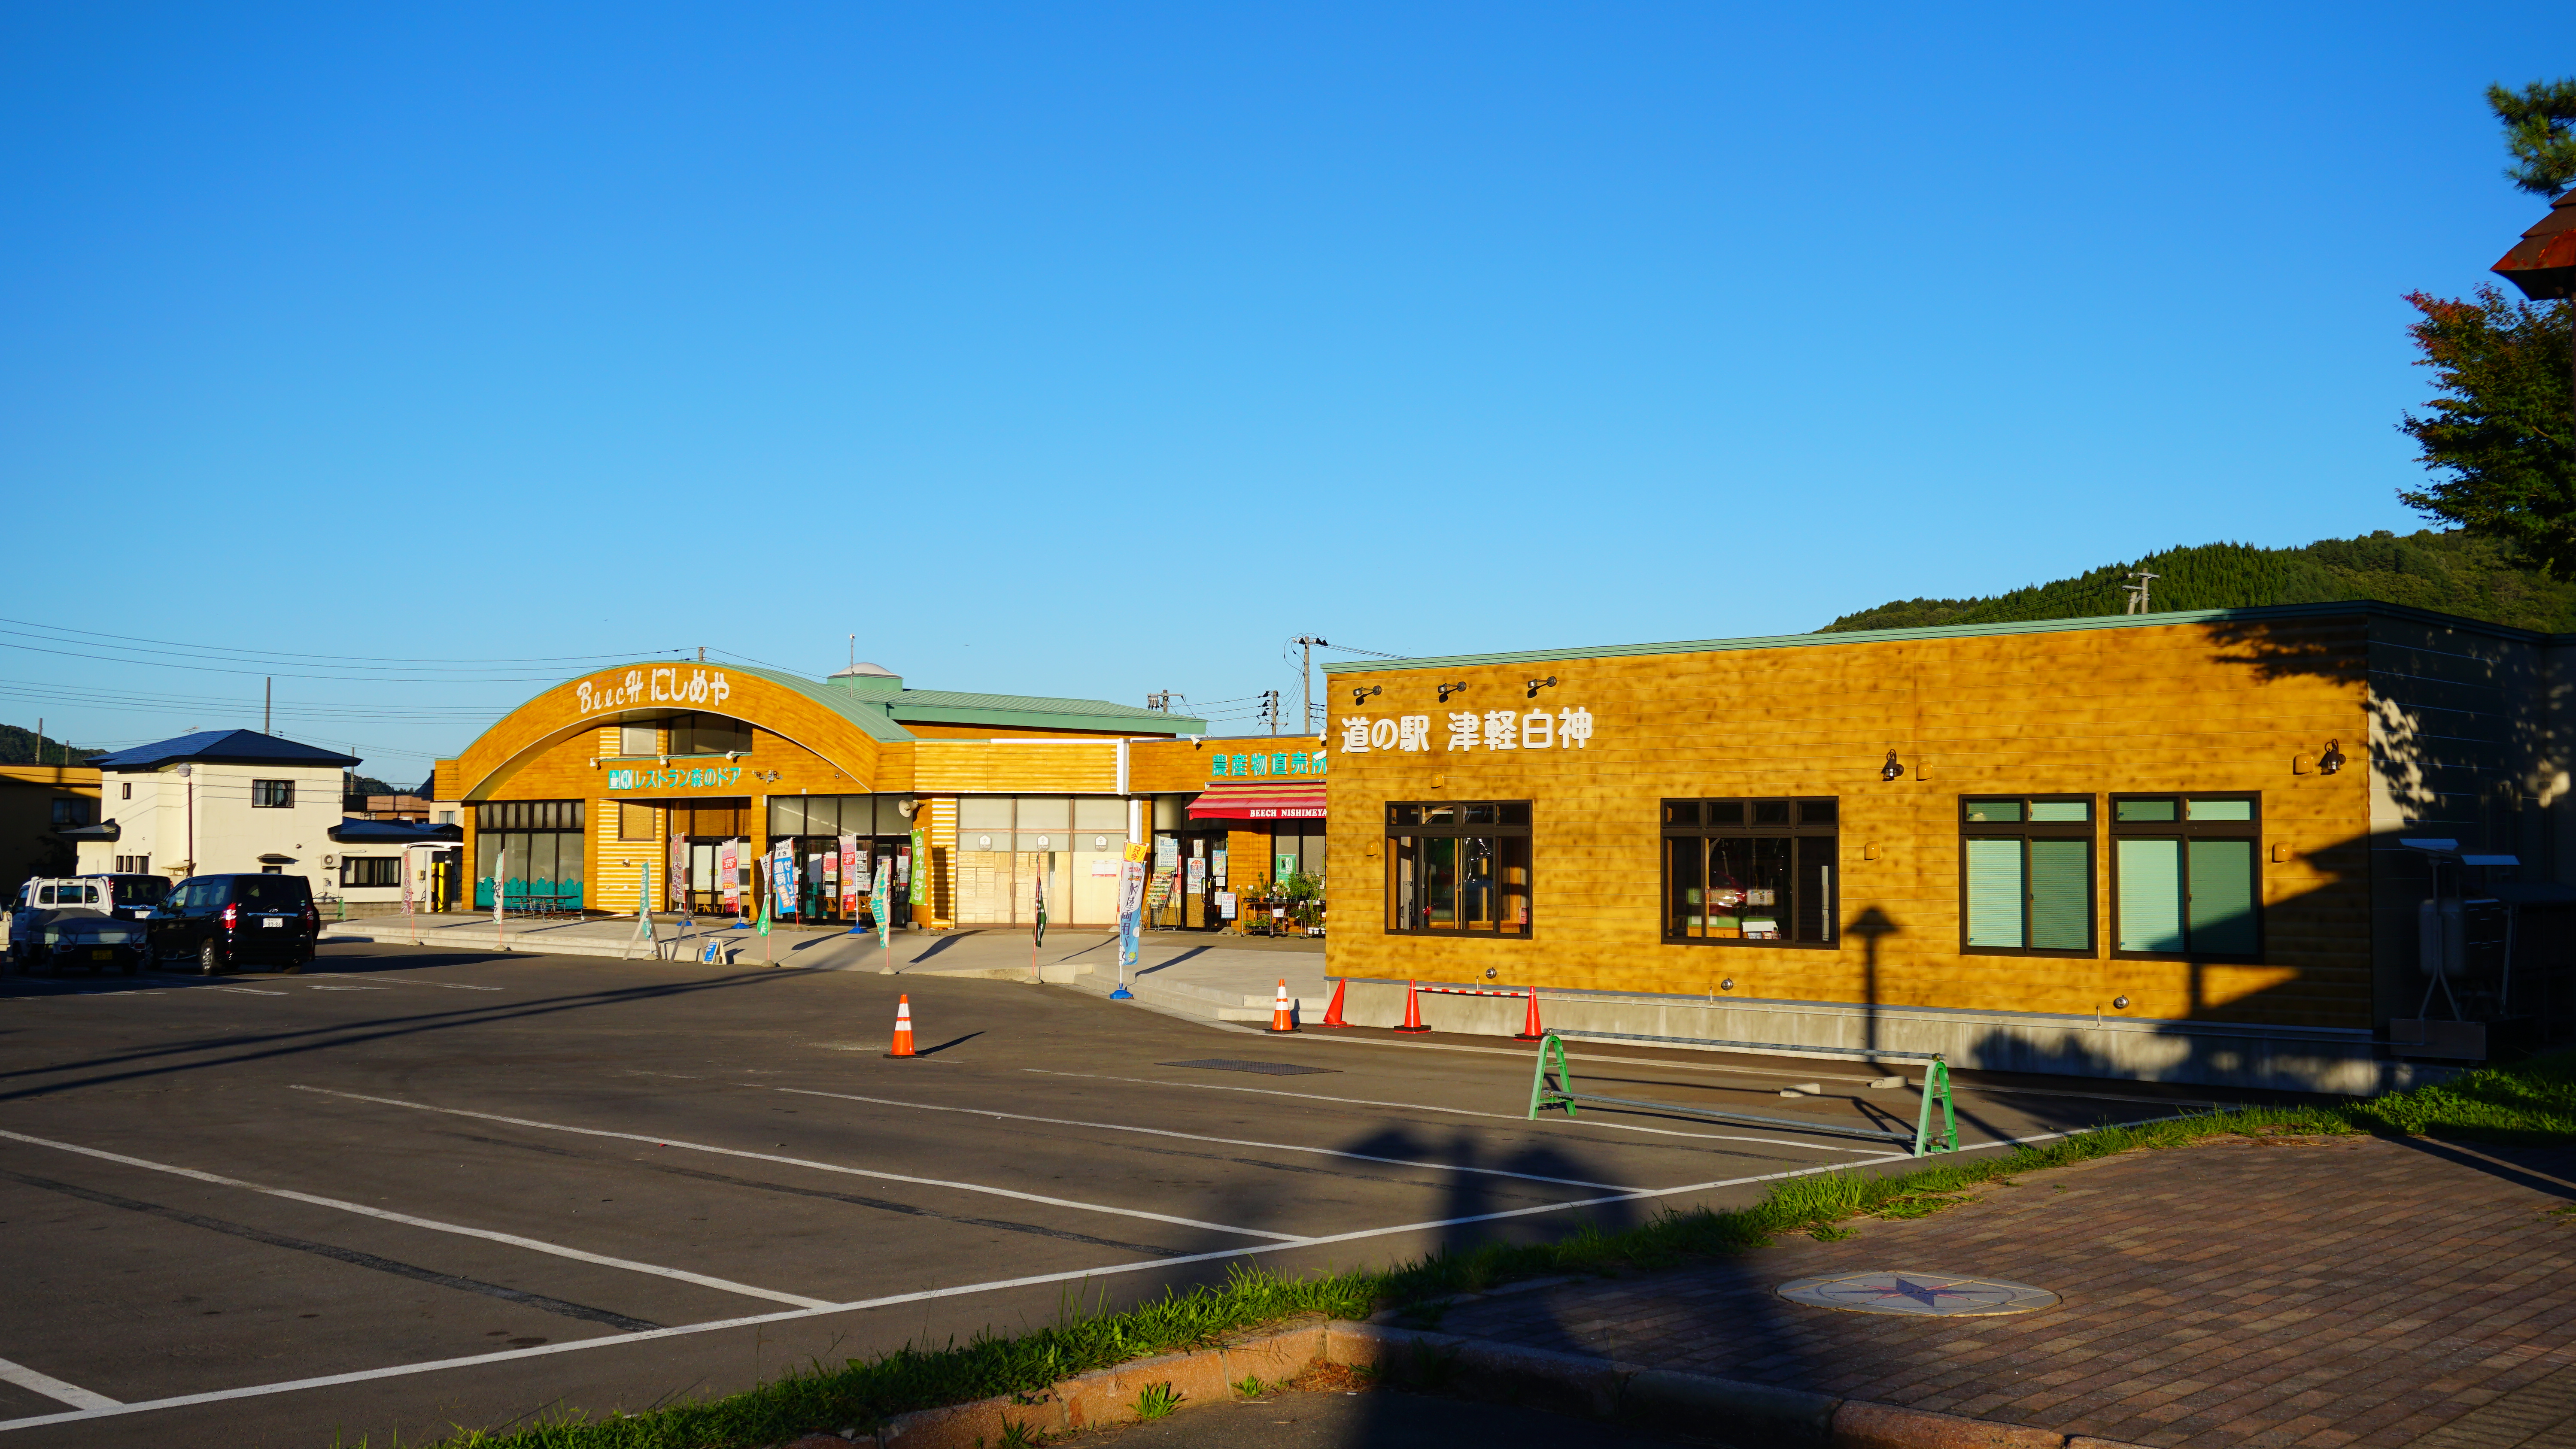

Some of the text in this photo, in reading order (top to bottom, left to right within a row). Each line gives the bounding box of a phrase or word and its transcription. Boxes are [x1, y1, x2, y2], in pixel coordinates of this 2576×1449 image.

[651, 667, 729, 706] にしめや
[1341, 707, 1592, 753] 道の駅 津軽白神
[635, 767, 741, 788] レストラン森のドア
[1212, 751, 1327, 776] 農産物直売所
[1281, 809, 1327, 817] NISHIMEYA
[1121, 883, 1138, 961] 水陸両用バス
